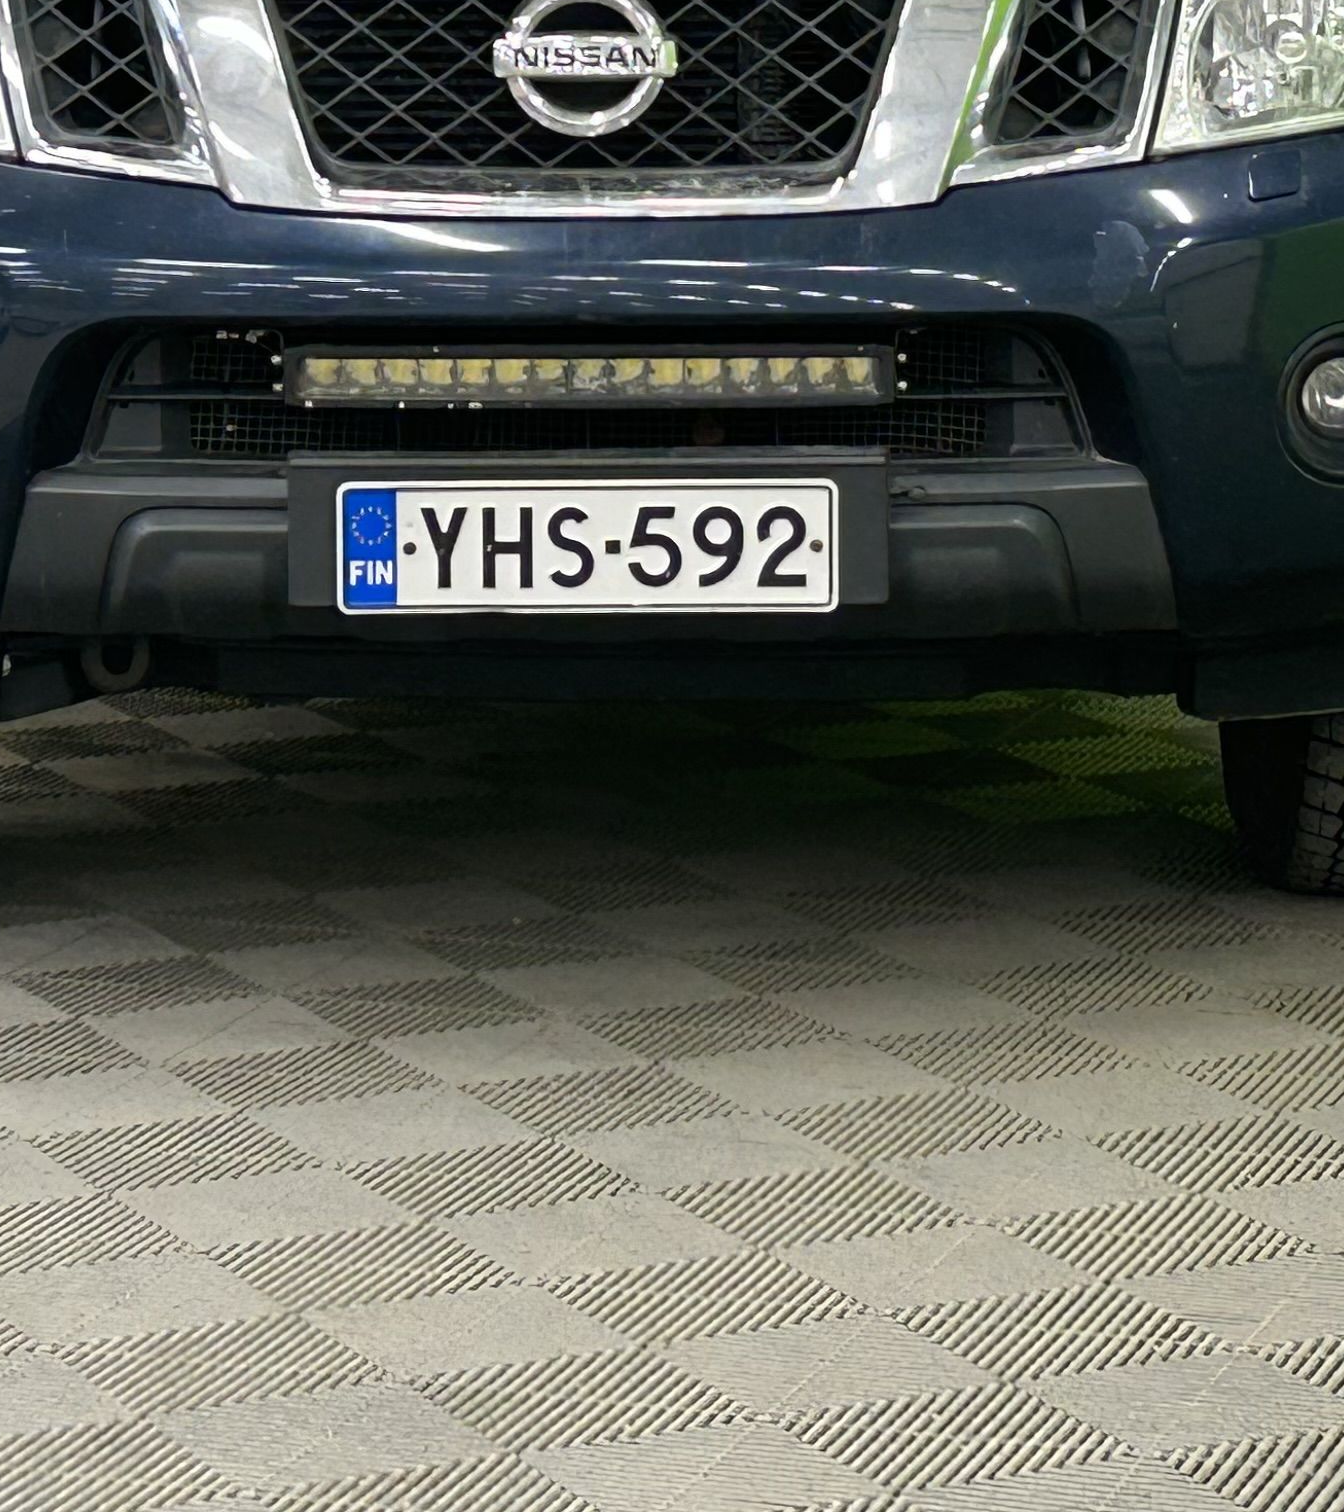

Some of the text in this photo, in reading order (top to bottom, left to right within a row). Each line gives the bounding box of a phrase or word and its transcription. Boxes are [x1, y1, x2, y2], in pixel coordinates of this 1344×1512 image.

[513, 46, 657, 68] NISSAN
[420, 506, 809, 589] YHS-592
[349, 560, 394, 586] FIN
